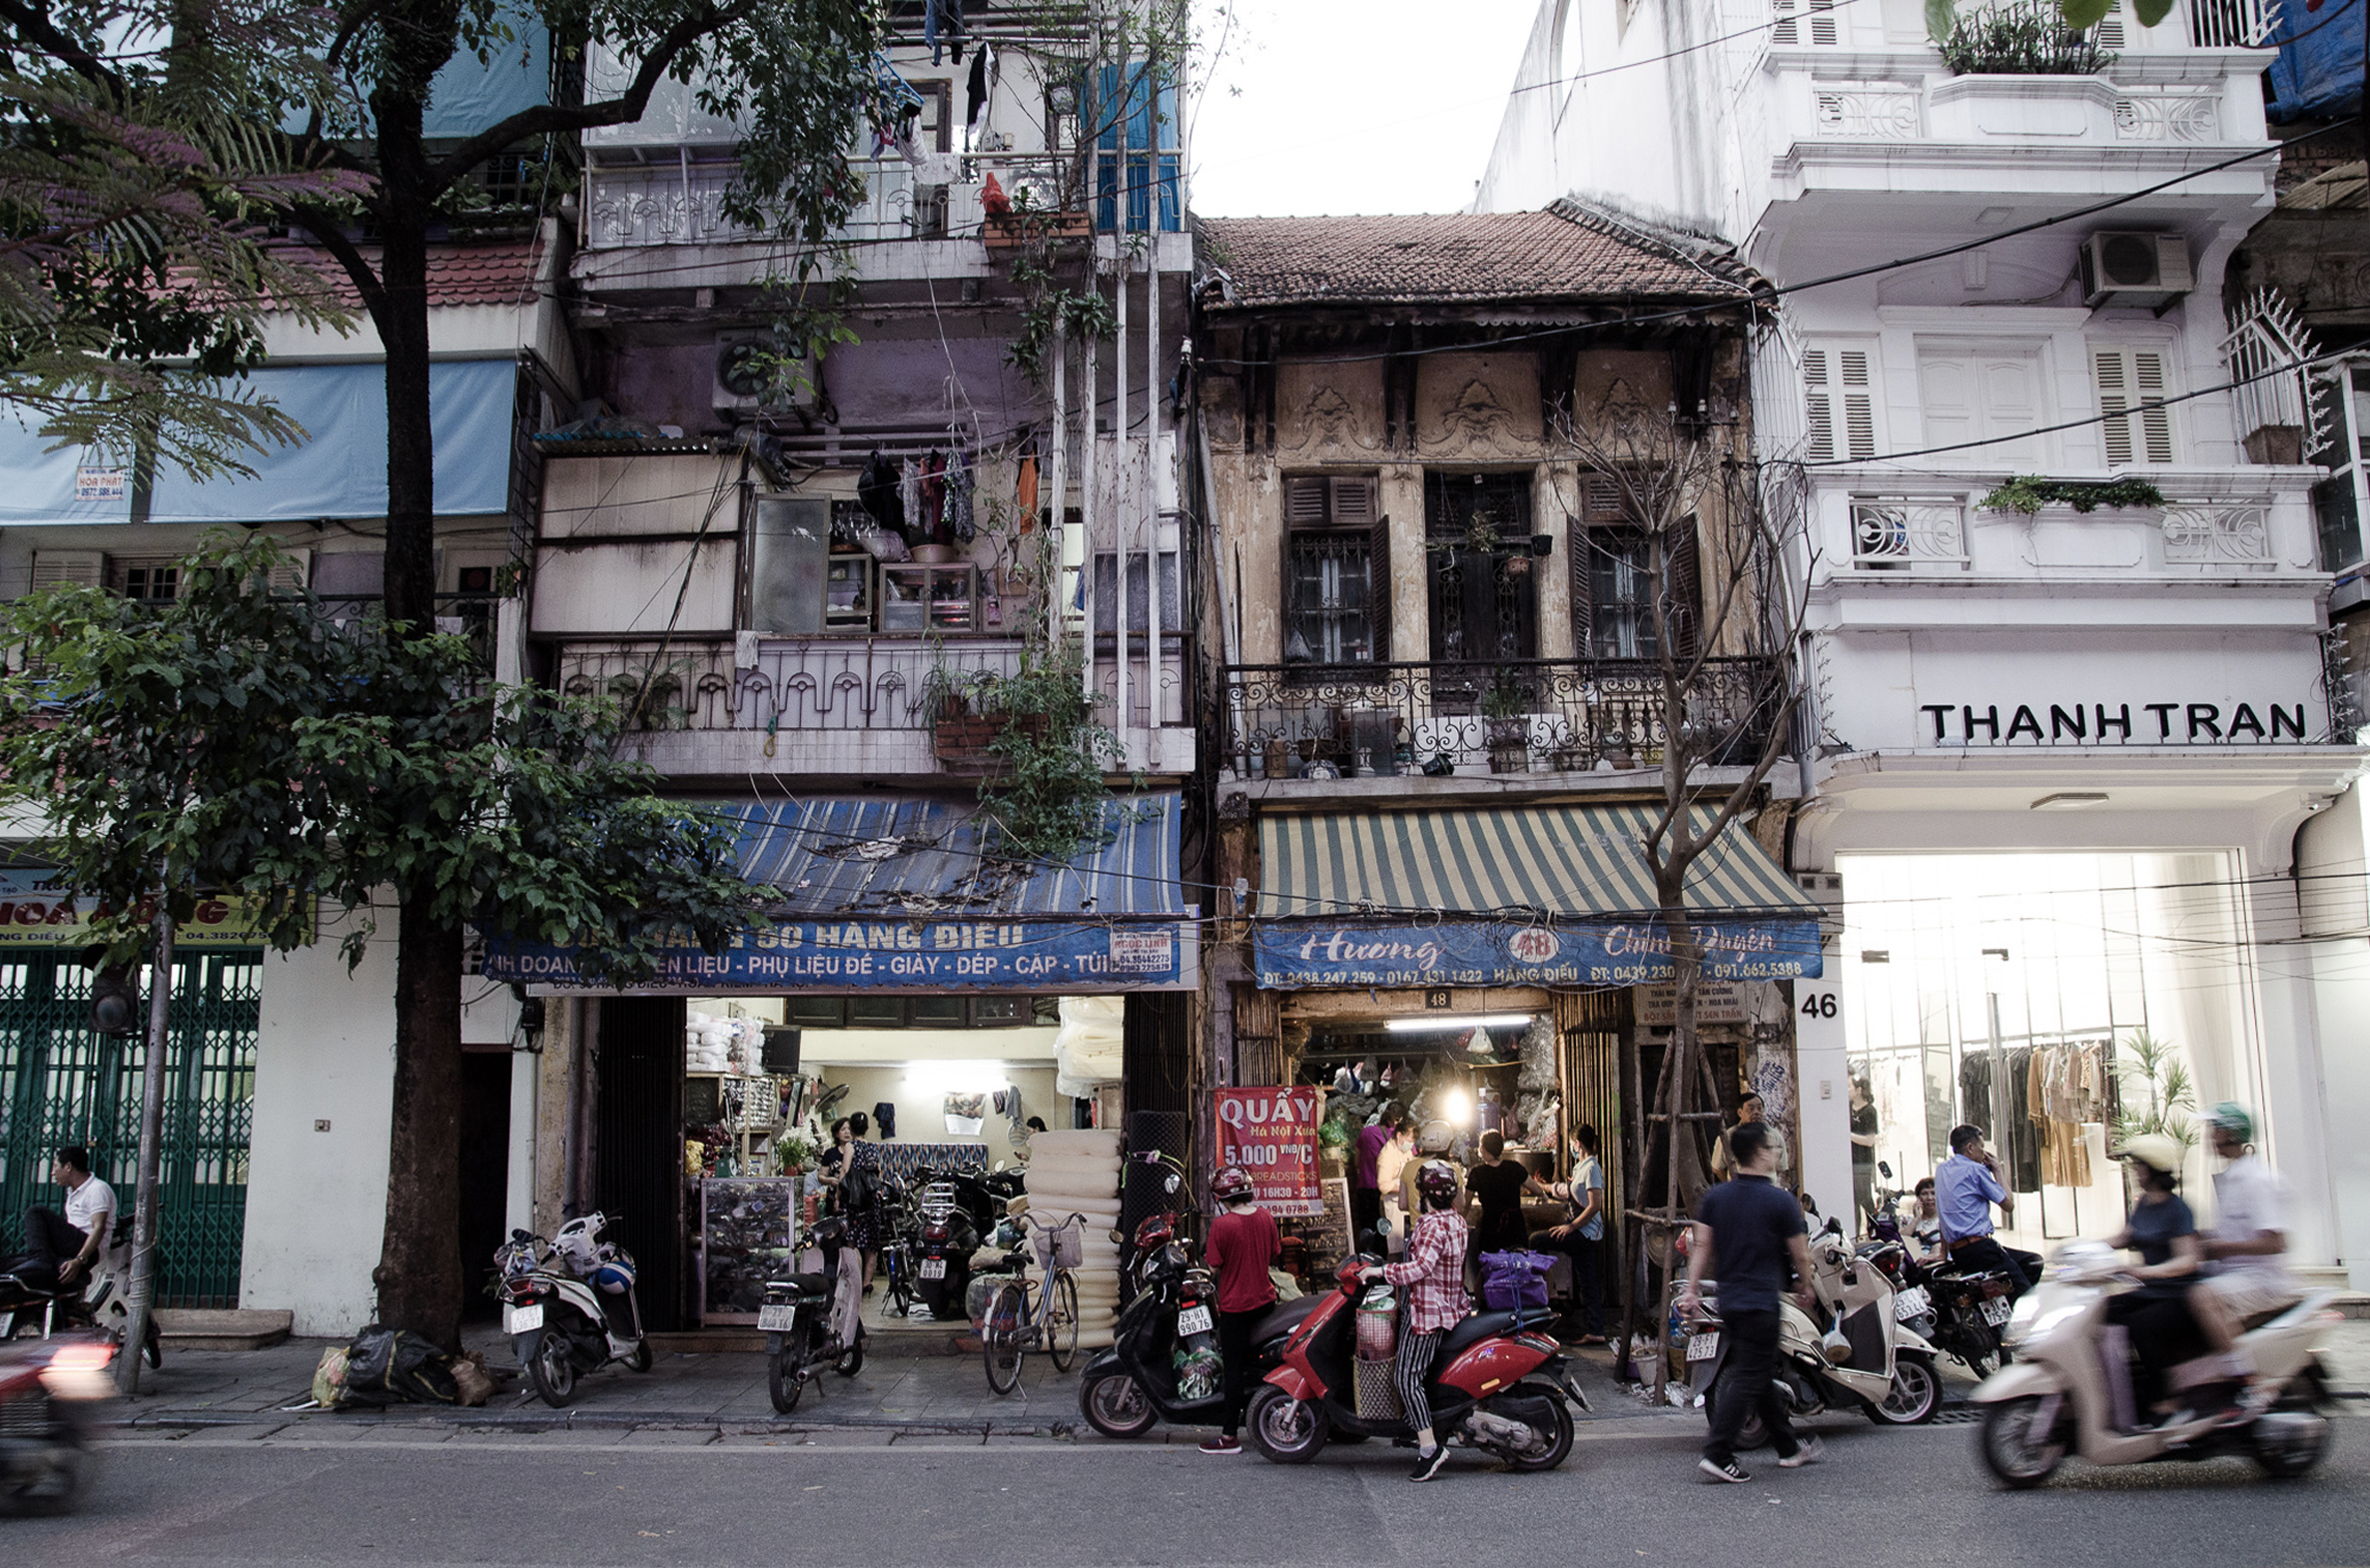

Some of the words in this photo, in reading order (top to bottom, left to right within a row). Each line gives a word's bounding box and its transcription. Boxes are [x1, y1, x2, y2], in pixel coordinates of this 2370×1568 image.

[1920, 703, 2132, 740] THANH
[2144, 702, 2306, 740] TRAN
[1516, 933, 1552, 957] 48
[748, 955, 789, 979] PHỤ
[794, 954, 840, 980] LIỆU
[890, 952, 941, 975] GIÀY
[1015, 953, 1058, 979] CẶP
[1075, 951, 1108, 974] TÚI
[1714, 962, 1803, 979] 091.662.5388
[1429, 992, 1447, 1007] 48
[1800, 993, 1839, 1020] 46
[1224, 1144, 1277, 1167] 5.000
